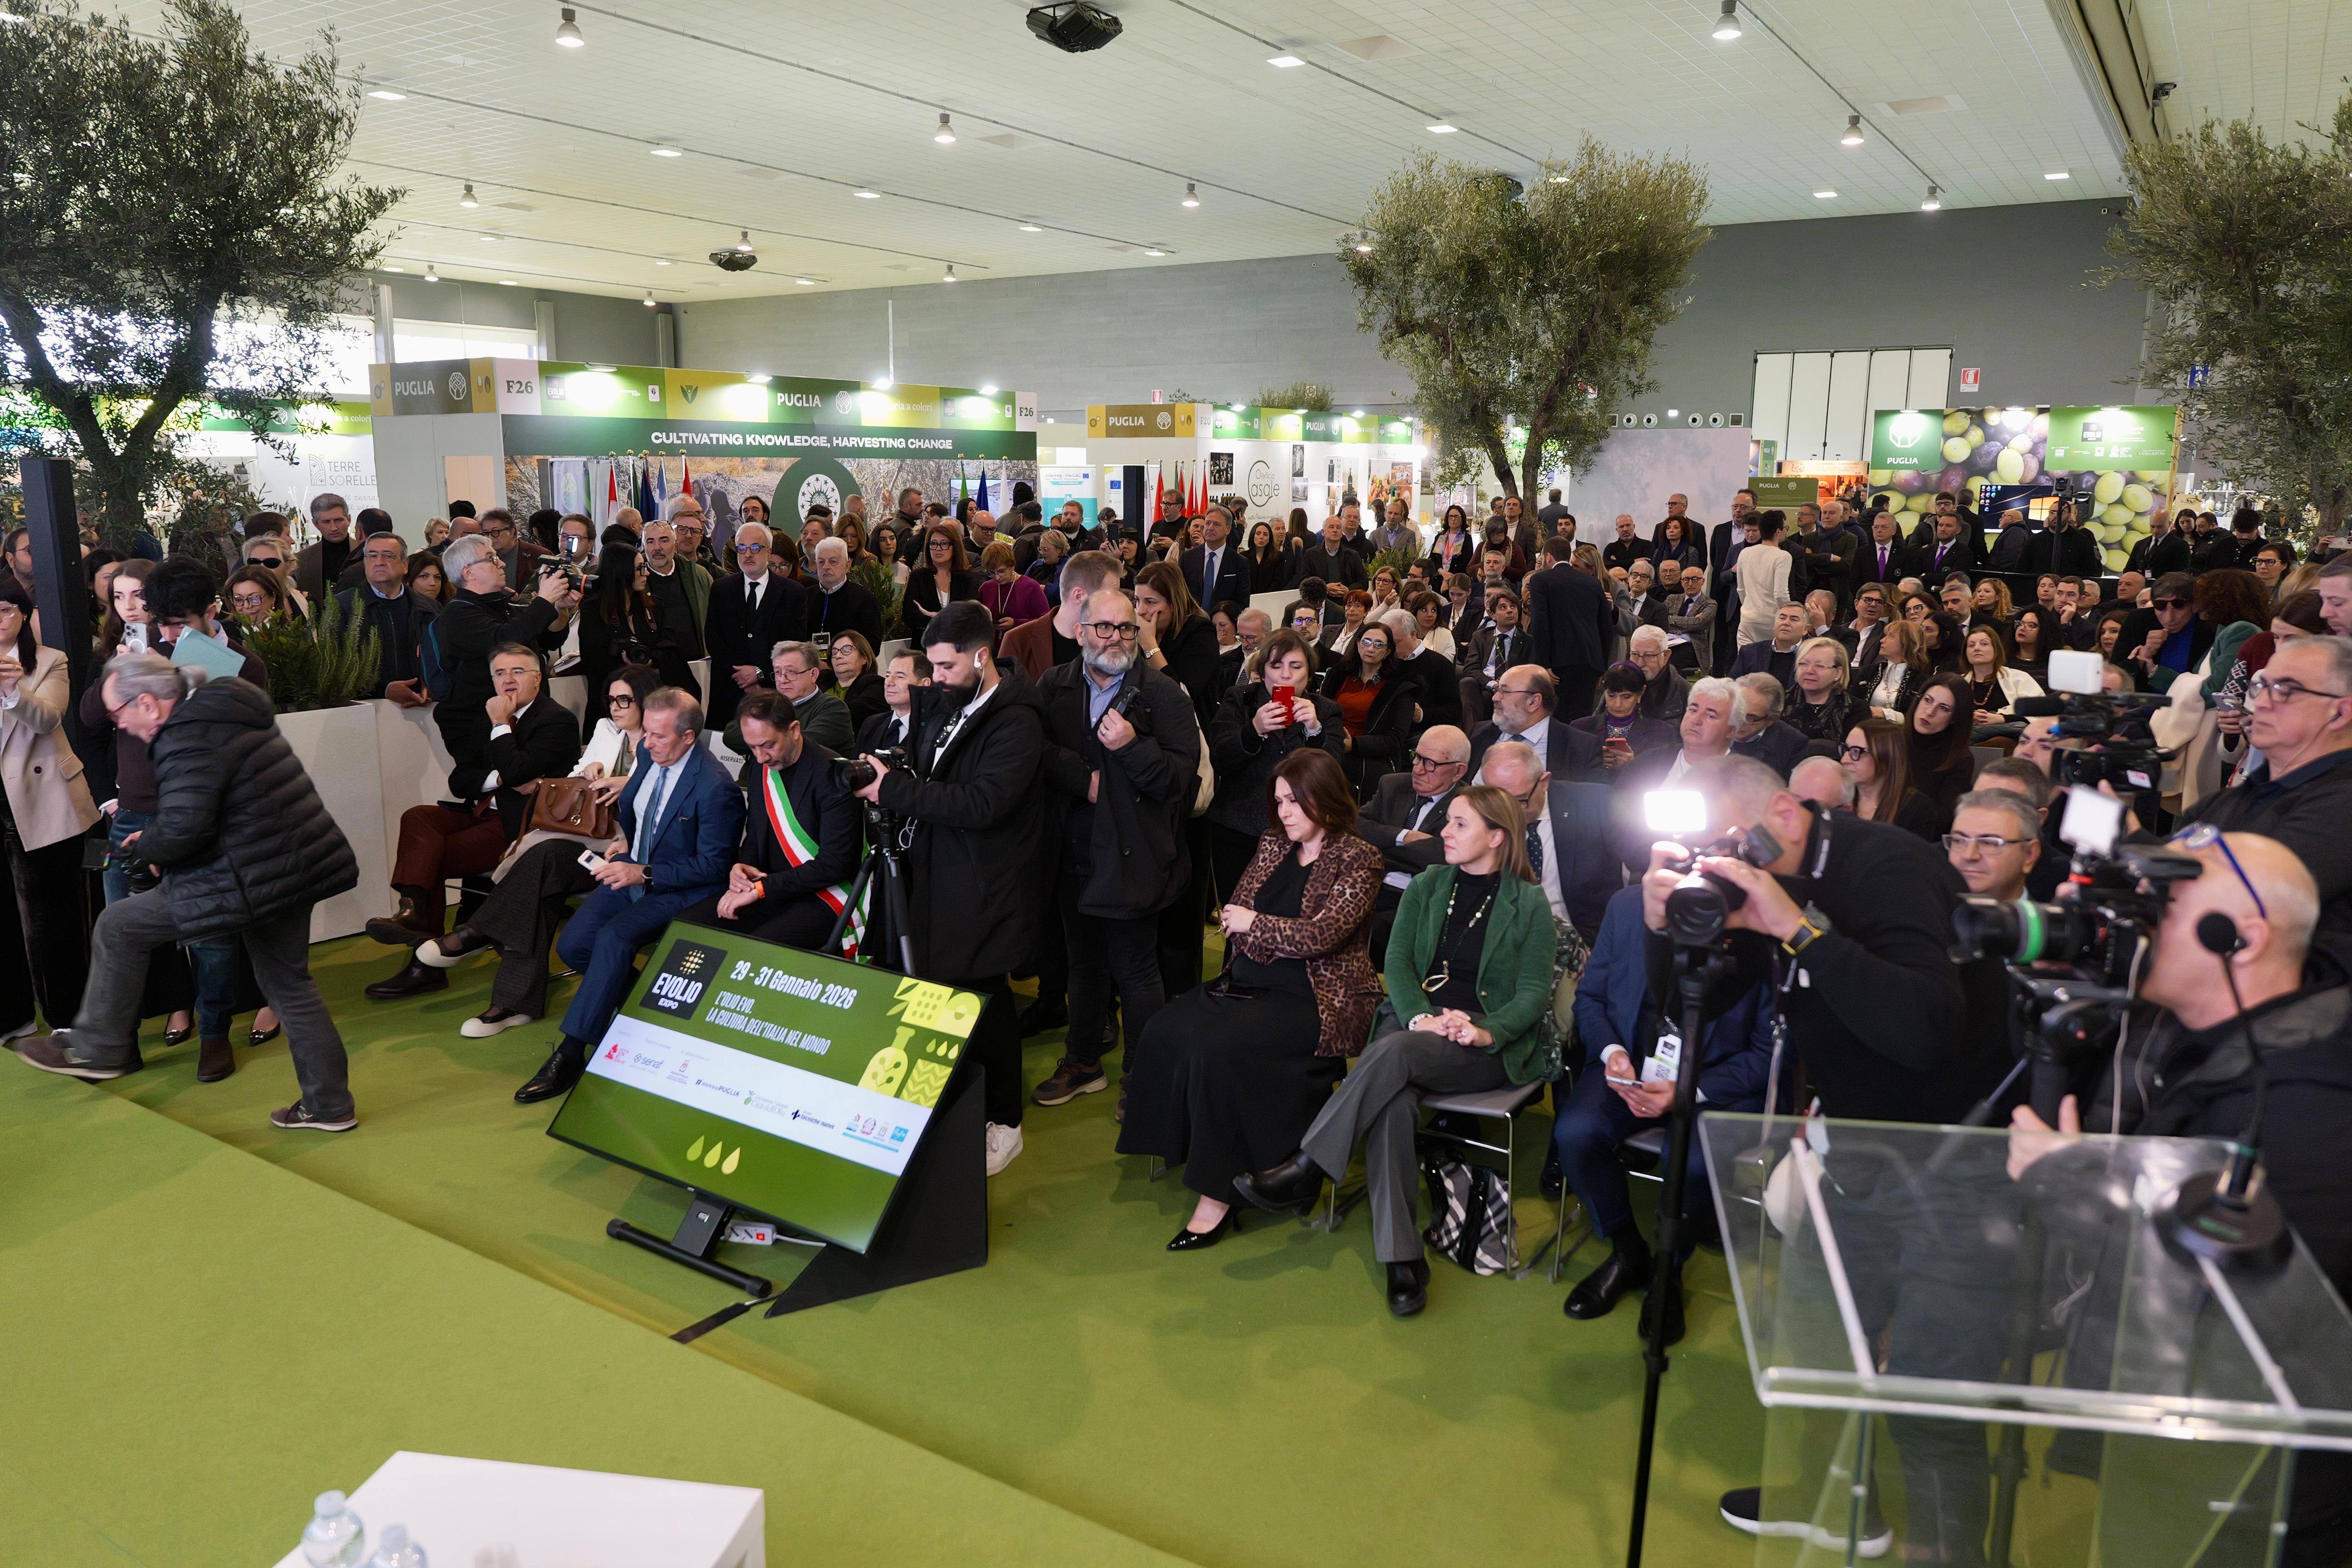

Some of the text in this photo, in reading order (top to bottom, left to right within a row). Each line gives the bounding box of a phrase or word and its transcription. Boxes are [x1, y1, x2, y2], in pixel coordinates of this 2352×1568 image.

[395, 380, 435, 396] PUGLIA
[506, 380, 533, 394] F26
[548, 387, 564, 396] EVOLIO
[777, 393, 821, 408] PUGLIA
[912, 402, 932, 412] colori
[1019, 407, 1034, 417] F26
[1109, 416, 1145, 426] PUGLIA
[1200, 416, 1211, 425] F20
[1306, 421, 1325, 431] PUGLIA
[651, 432, 952, 449] CULTIVATING KNOWLEDGE, HARVESTING CHANGE
[328, 461, 361, 472] TERRE
[1255, 469, 1275, 479] Oleificio
[329, 475, 377, 486] SORELLE
[720, 755, 744, 764] RISERVATO
[652, 972, 702, 1004] EVOLIO
[730, 960, 751, 981] 29
[754, 966, 774, 987] 31
[769, 970, 823, 1001] Gennaio
[820, 983, 858, 1010] 2026
[658, 997, 678, 1009] EXPO
[714, 991, 755, 1014] L'OLIO EVO.
[705, 1007, 831, 1056] LA CULTURA DELL'ITALIA NEL MONDO
[641, 1057, 665, 1070] senaf
[801, 1115, 835, 1129] tecniche nuove
